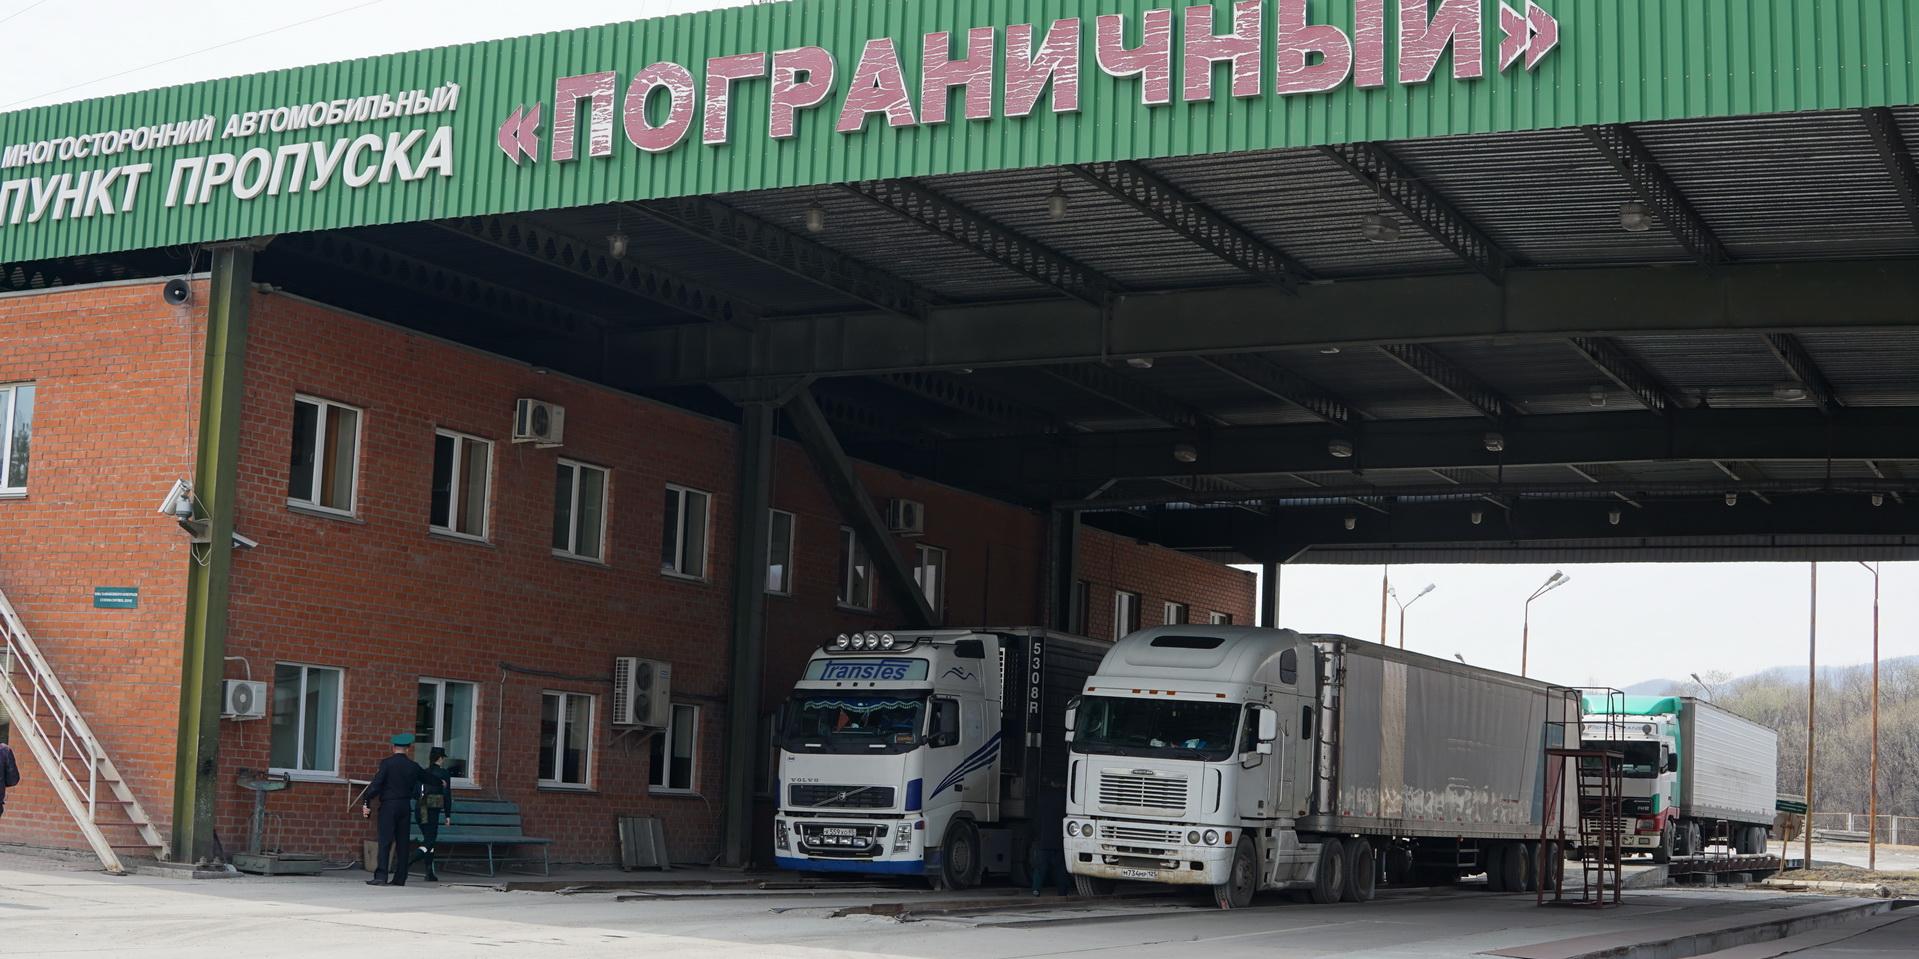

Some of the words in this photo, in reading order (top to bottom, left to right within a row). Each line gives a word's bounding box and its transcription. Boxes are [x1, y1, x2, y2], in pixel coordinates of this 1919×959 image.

[1, 114, 216, 169] МНОГОСТОРОННИЙ
[222, 81, 461, 139] АВТОМОБИЛЬНЫЙ
[0, 162, 152, 226] ПУНКТ
[165, 125, 453, 207] ПРОПУСКА
[1029, 642, 1041, 714] 5308R
